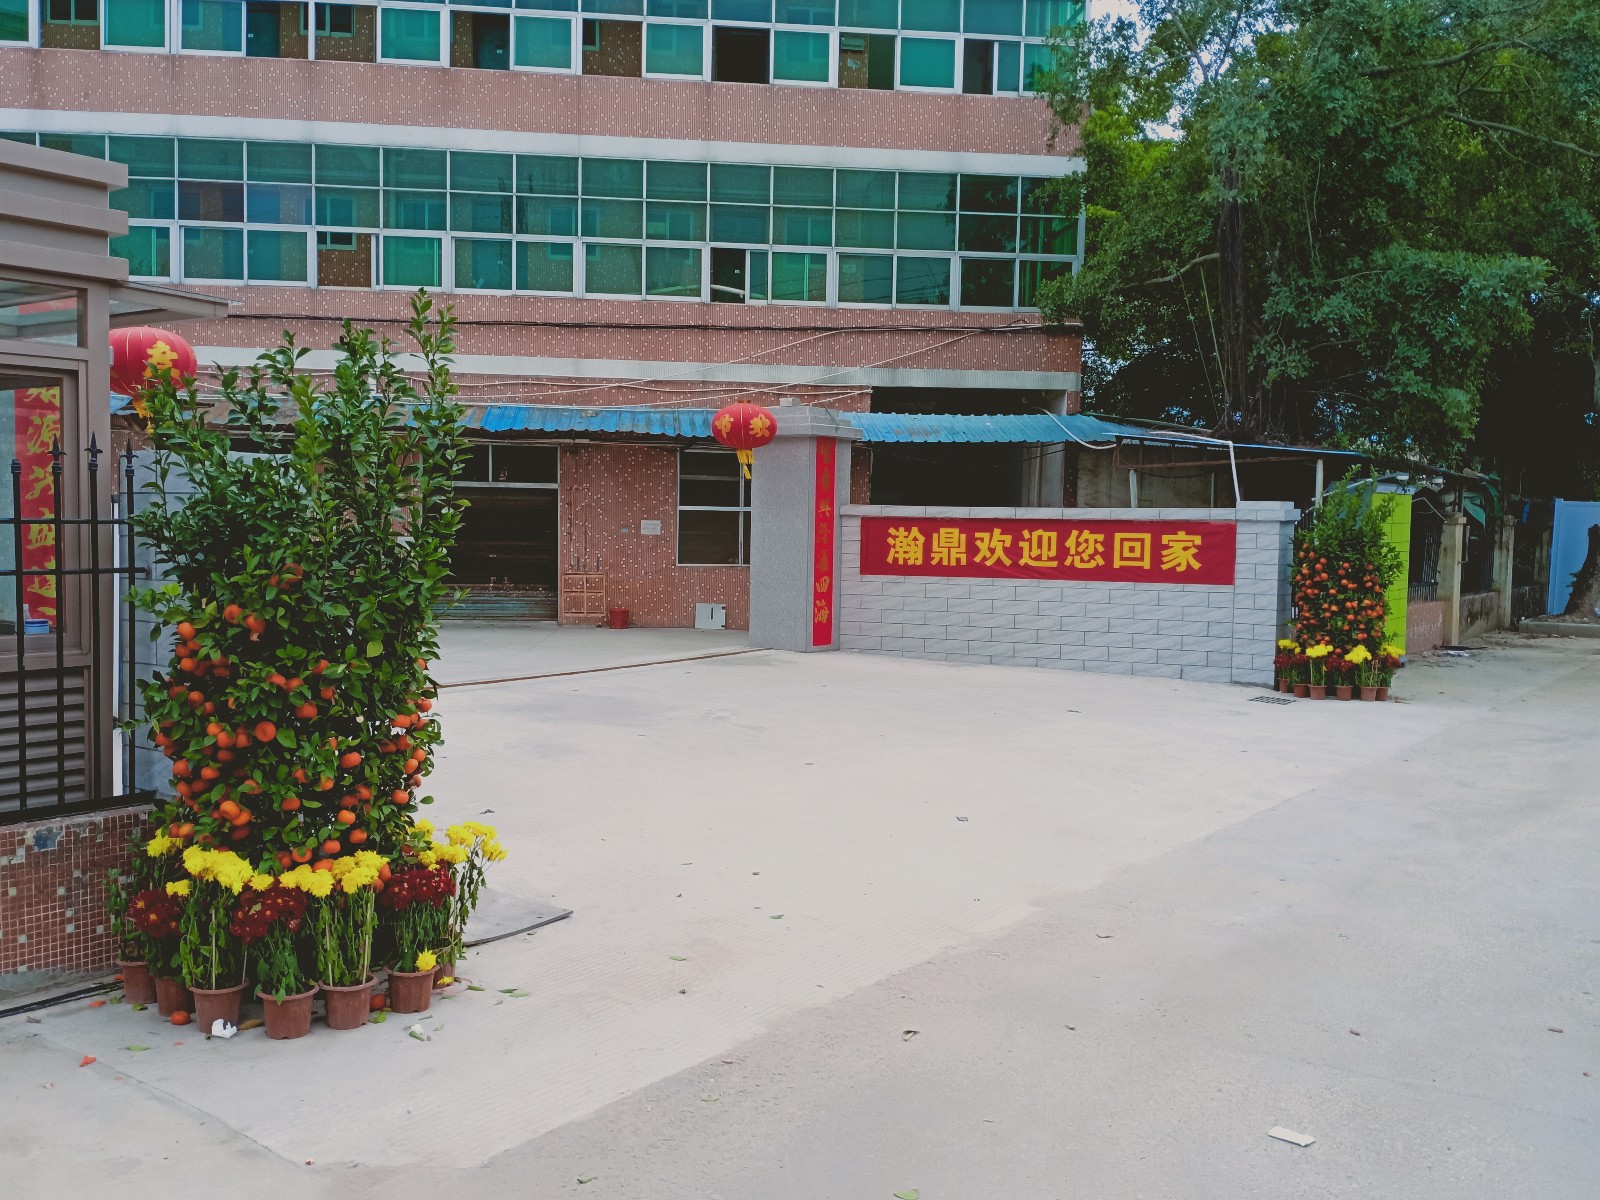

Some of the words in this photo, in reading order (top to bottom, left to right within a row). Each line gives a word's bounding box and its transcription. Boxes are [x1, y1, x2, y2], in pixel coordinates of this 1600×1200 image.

[886, 526, 1203, 572] 瀚鼎欢迎您回家
